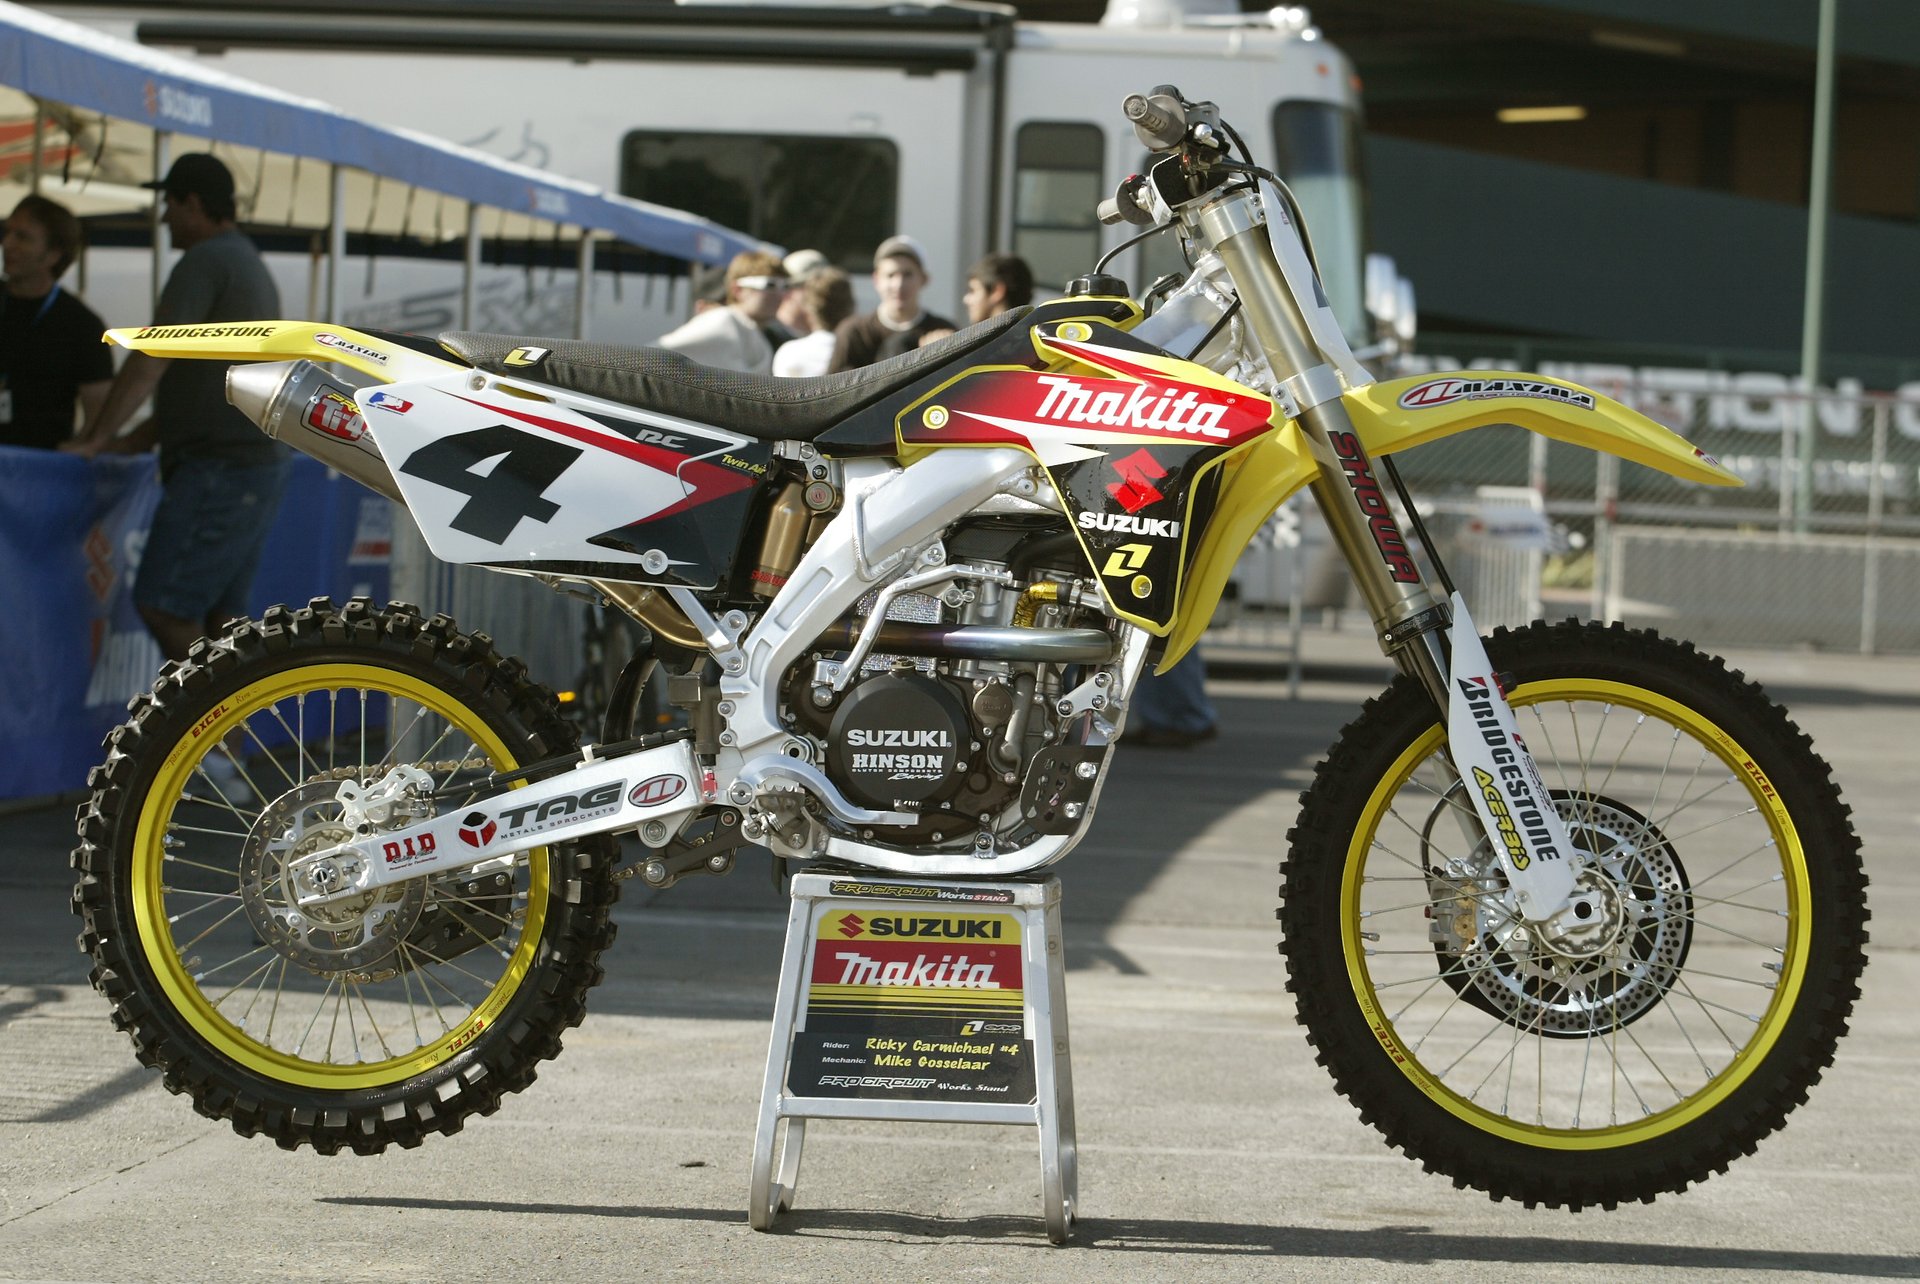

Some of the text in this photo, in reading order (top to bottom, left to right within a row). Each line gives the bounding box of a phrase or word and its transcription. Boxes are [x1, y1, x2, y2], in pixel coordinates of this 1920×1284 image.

[133, 326, 276, 340] BRIDGESTONE
[335, 341, 388, 361] MAXIMA
[1453, 380, 1592, 406] MAXIMA
[1035, 375, 1230, 439] Makita
[635, 428, 689, 449] RC
[721, 453, 750, 469] Twin
[398, 424, 585, 546] 4
[1327, 430, 1421, 584] SHOWA
[1078, 511, 1180, 538] SUZUKI
[192, 704, 230, 738] EXCEL
[847, 729, 947, 747] SUZUKI
[852, 754, 943, 768] HINSON
[1456, 676, 1561, 862] BRIDGESTONE
[1743, 760, 1776, 802] EXCEL
[498, 781, 623, 830] TAG
[500, 806, 616, 840] METALS SPROCKETS
[937, 891, 974, 901] Works
[973, 894, 1009, 902] STAND
[869, 917, 1001, 939] SUZUKI
[835, 952, 1000, 989] Makita
[446, 1019, 485, 1052] EXCEL
[866, 1037, 1020, 1056] Ricky Carmichael #4
[1373, 1022, 1406, 1065] EXCEL
[822, 1056, 867, 1064] Mechanic:
[874, 1054, 991, 1071] Mike Gosselaar
[937, 1082, 972, 1092] Works
[976, 1083, 1009, 1093] Stand
